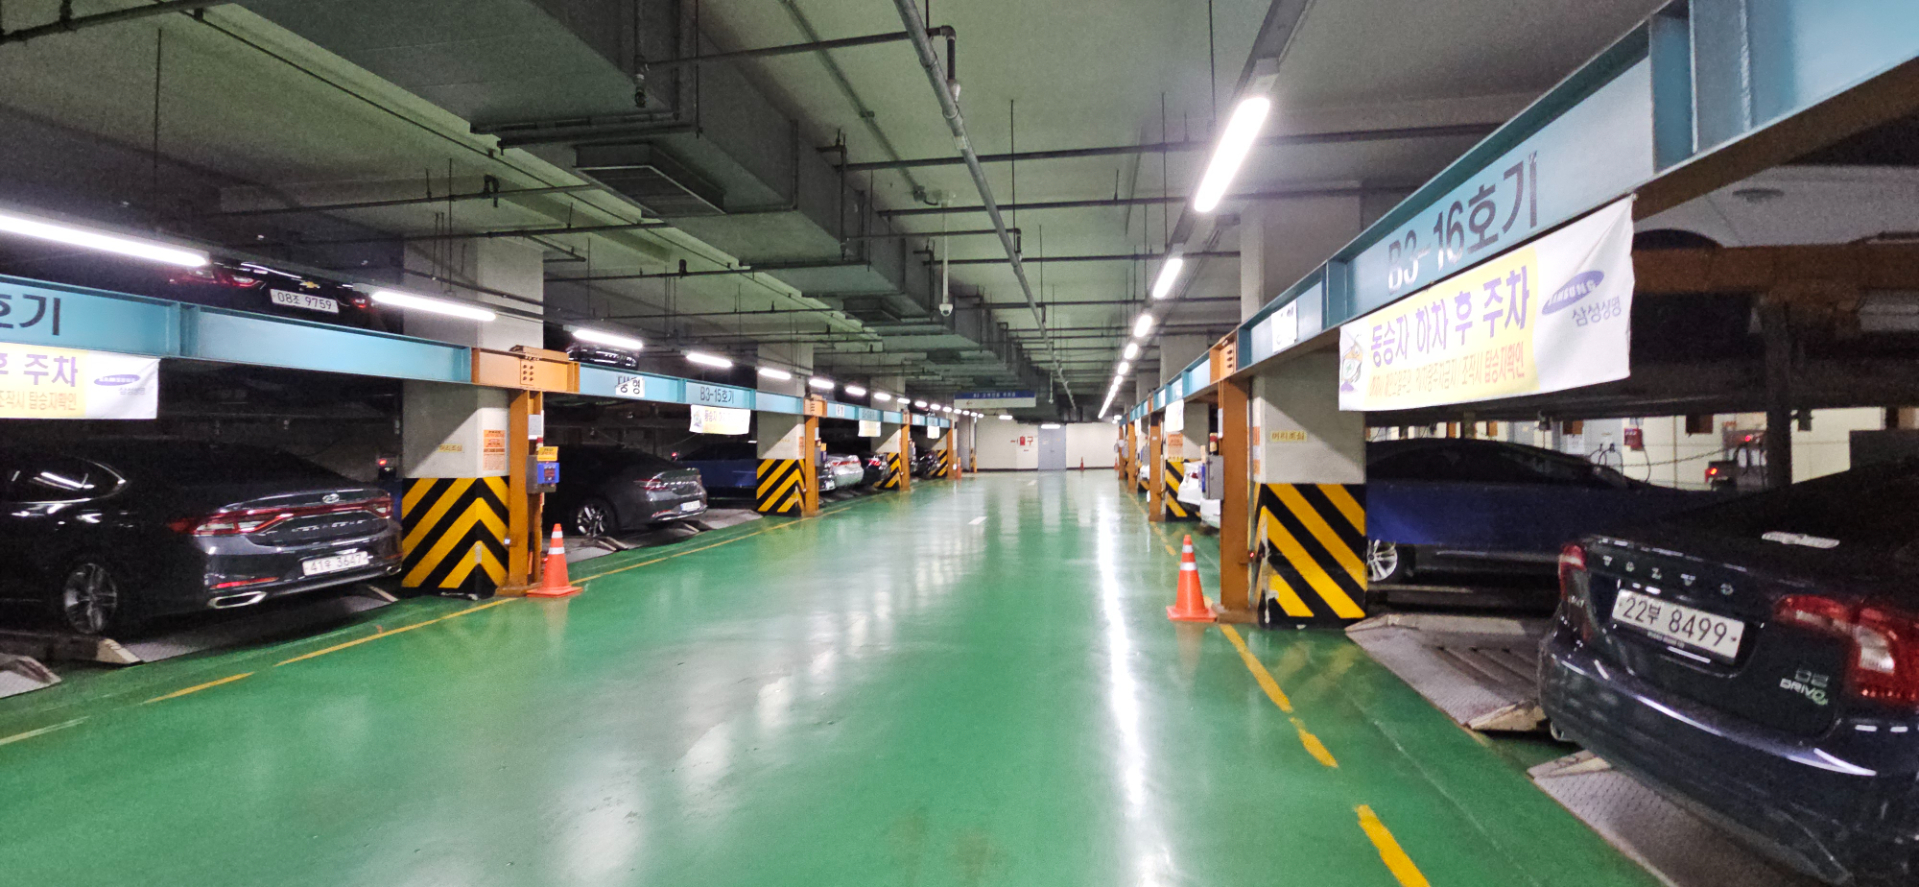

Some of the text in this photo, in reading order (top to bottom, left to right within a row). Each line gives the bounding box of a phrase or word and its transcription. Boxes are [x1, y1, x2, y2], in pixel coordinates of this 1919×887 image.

[1388, 151, 1537, 295] B3-16호기
[304, 296, 332, 310] 9759
[1371, 266, 1529, 367] 동승자 하차 후 주차
[23, 353, 78, 387] 주차
[700, 386, 734, 404] B3-15호기
[1622, 597, 1661, 625] 22부
[1669, 609, 1727, 646] 8499
